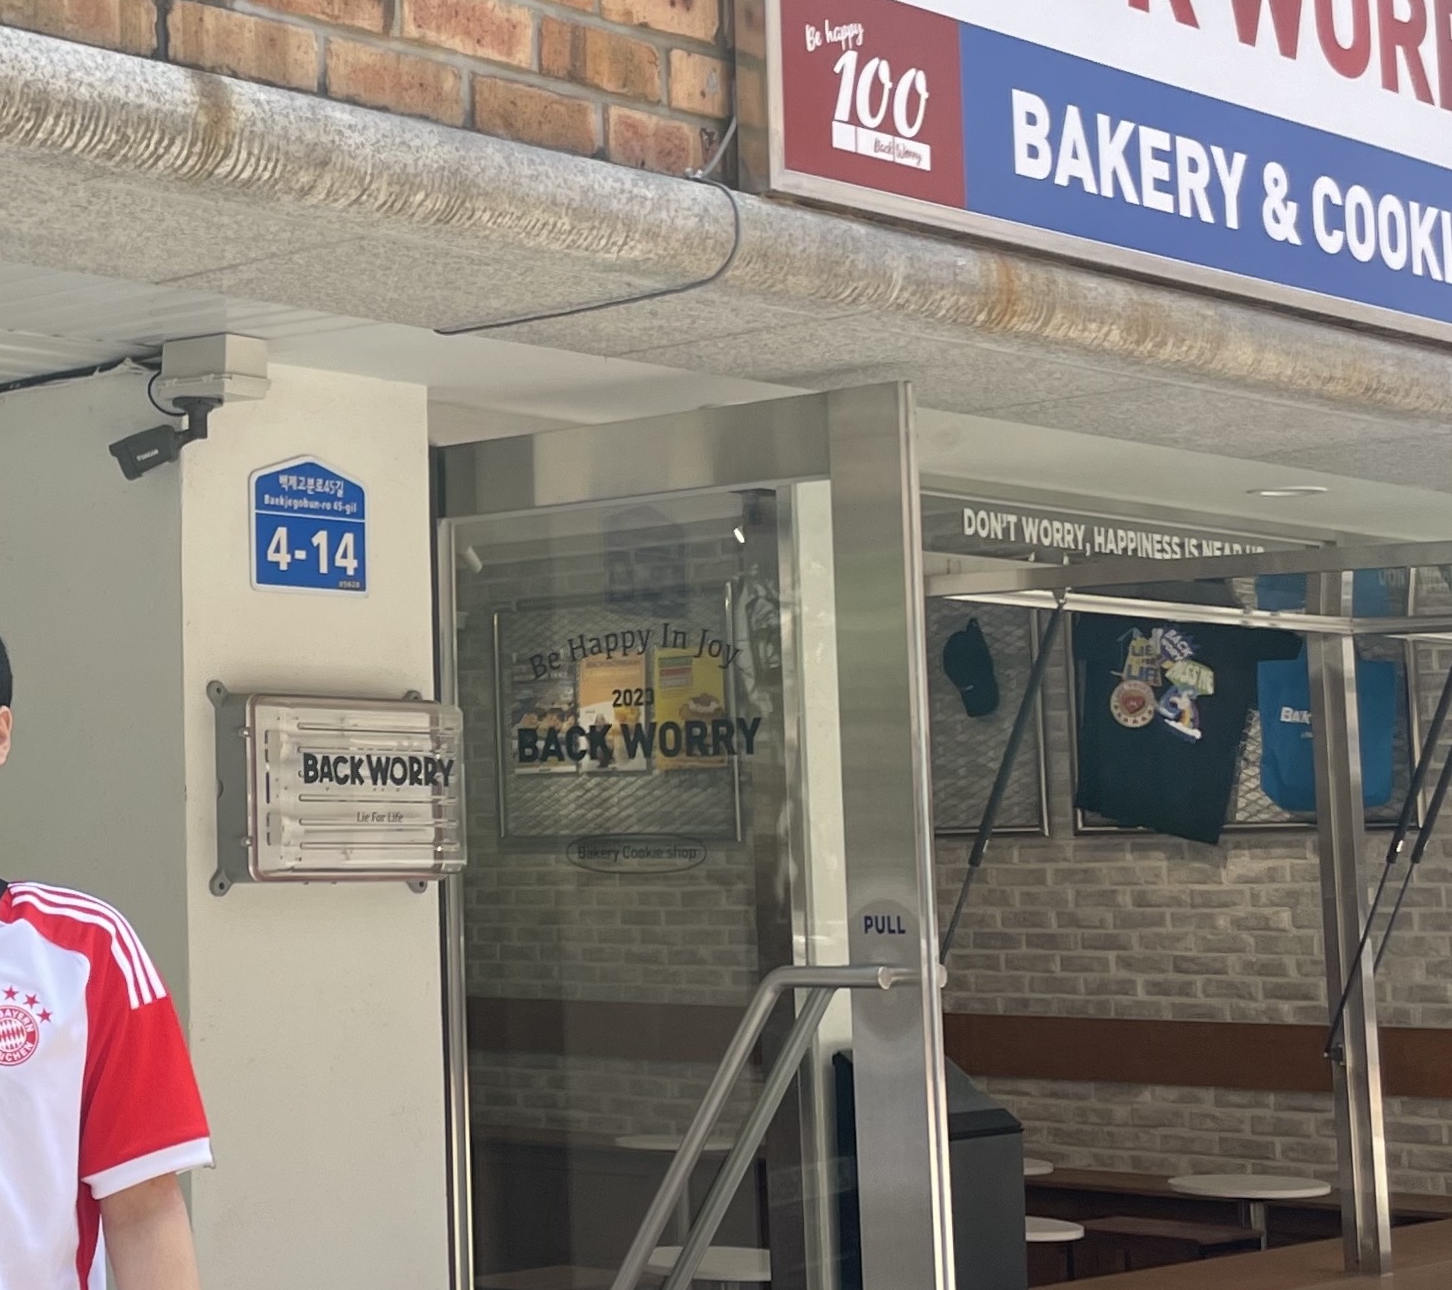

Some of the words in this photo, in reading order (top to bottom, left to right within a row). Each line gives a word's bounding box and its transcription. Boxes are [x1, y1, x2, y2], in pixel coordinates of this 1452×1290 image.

[805, 23, 823, 52] Be
[824, 19, 864, 51] happy
[833, 49, 929, 138] 100
[1011, 88, 1247, 230] BAKERY
[1262, 161, 1304, 246] &
[278, 474, 344, 498] 백제고분로45길
[263, 494, 332, 510] Baekjegobun-ro
[333, 500, 357, 515] 45-gil
[266, 526, 359, 576] 4-14
[963, 508, 1018, 542] DON'T
[1021, 516, 1091, 556] WORRY,
[1093, 526, 1181, 560] HAPPINESS
[1184, 538, 1199, 558] IS
[529, 650, 562, 680] Be
[567, 628, 652, 661] Happy
[661, 622, 688, 649] In
[692, 628, 743, 670] Joy
[611, 687, 655, 708] 2023
[517, 723, 615, 763] BACK
[619, 716, 762, 761] WORRY
[303, 752, 365, 786] BACK
[365, 754, 455, 788] WORRY
[356, 811, 370, 823] Lie
[371, 811, 386, 823] For
[387, 811, 404, 823] Life
[578, 845, 619, 862] Bakery
[622, 845, 665, 860] Cookie
[666, 844, 698, 862] shop
[863, 915, 906, 935] PULL
